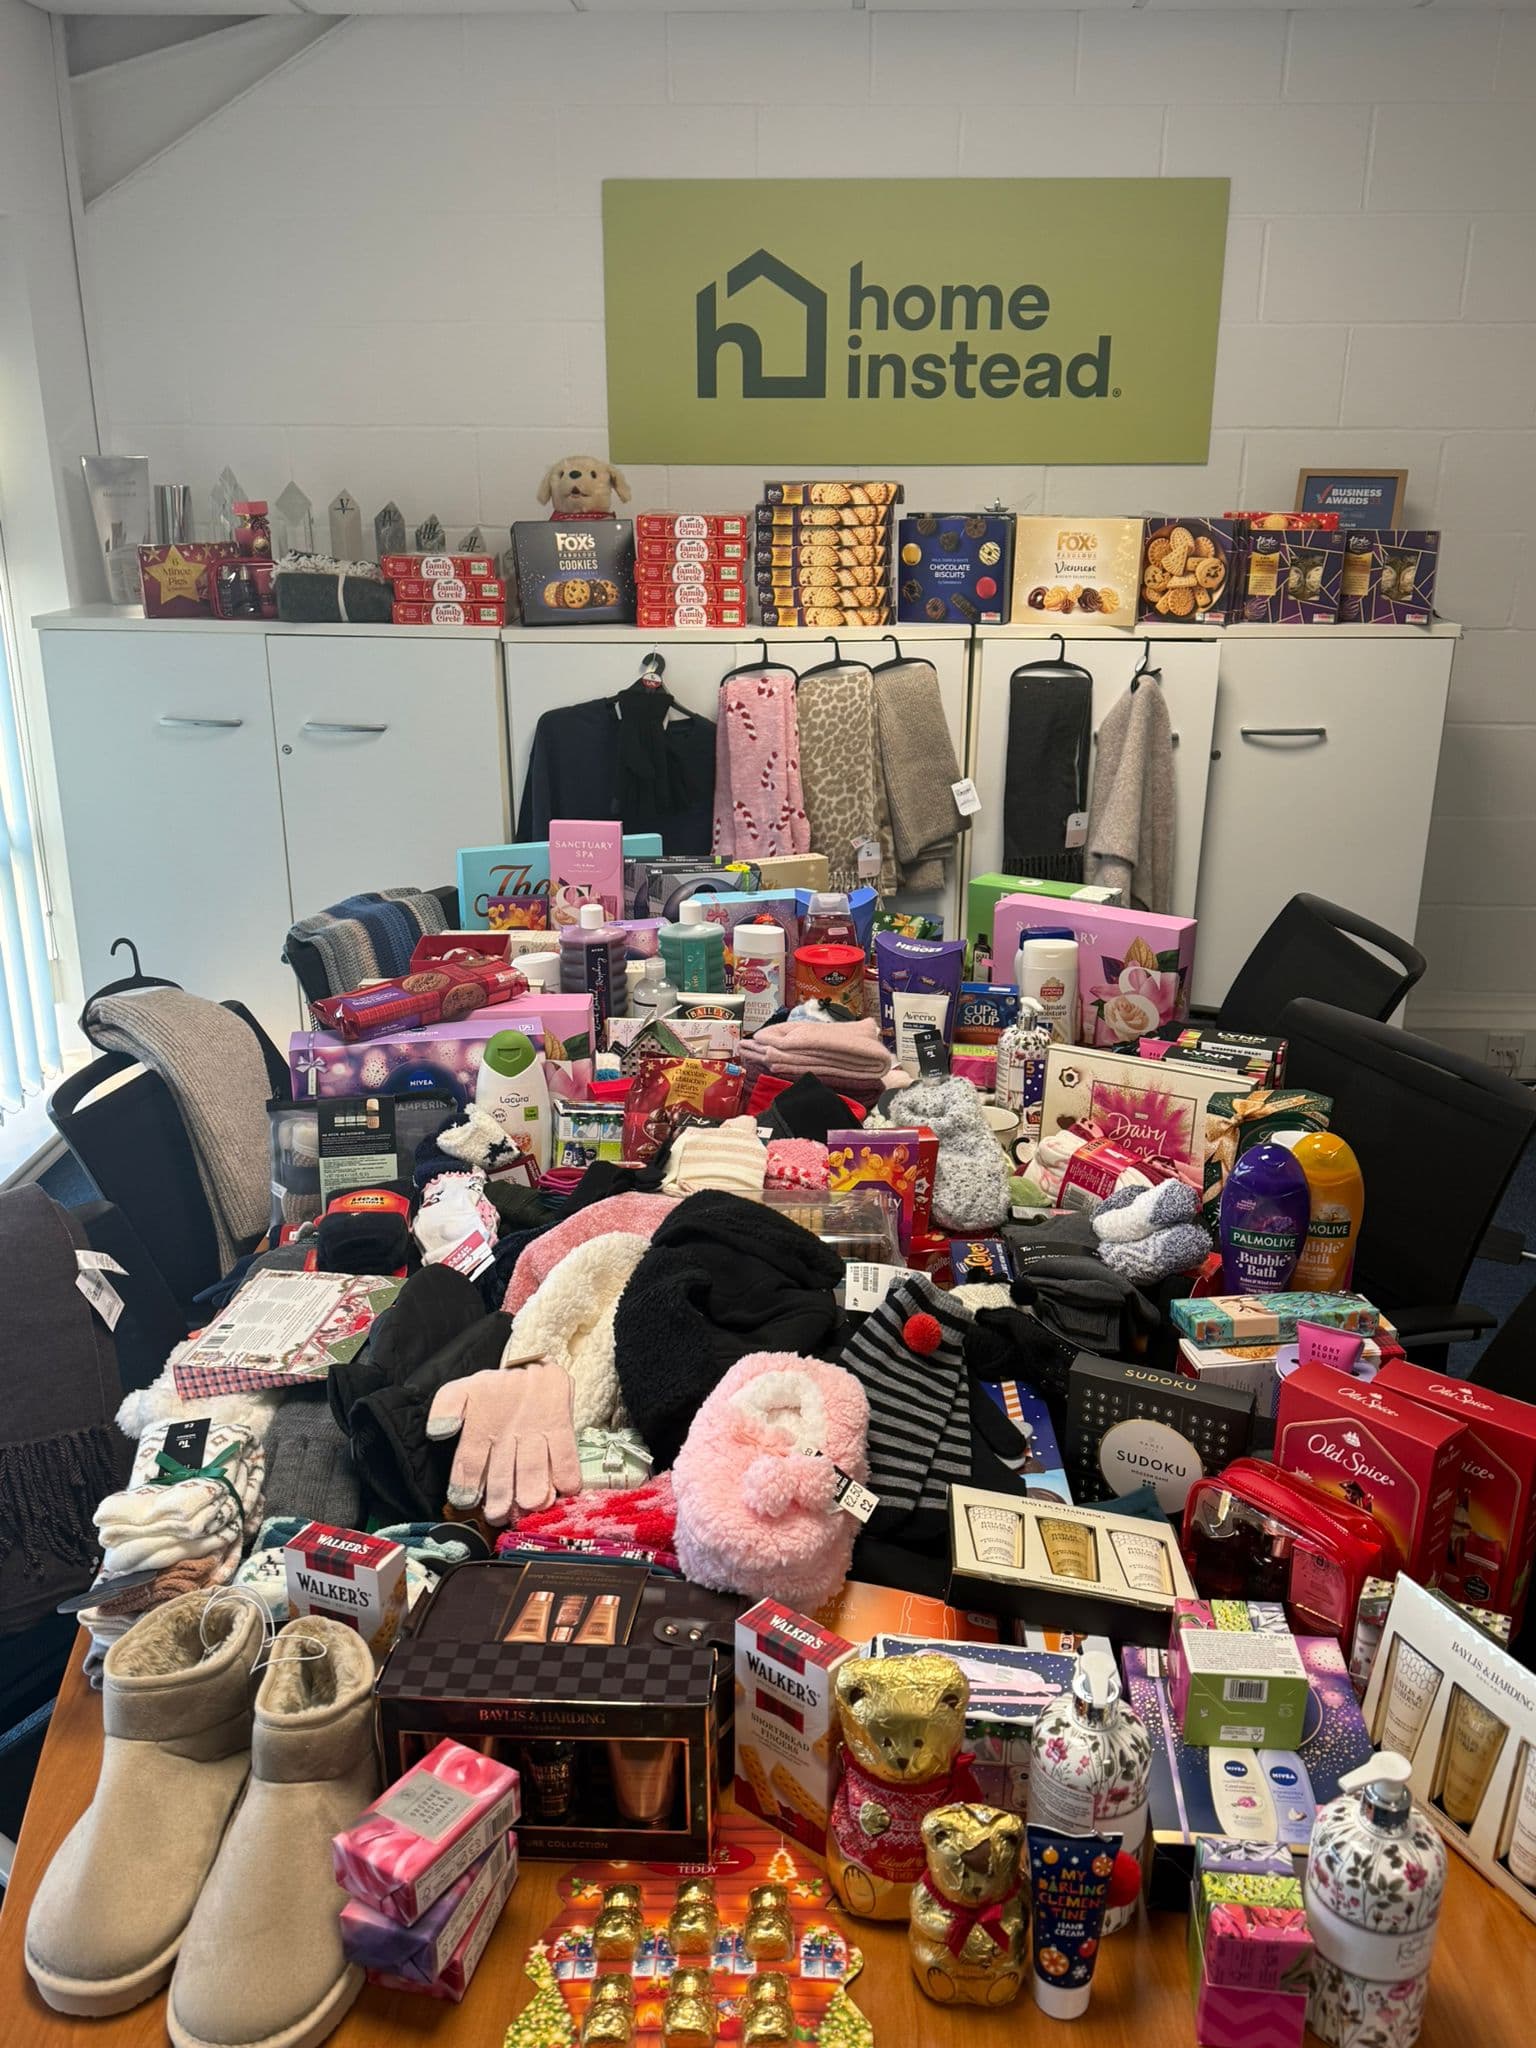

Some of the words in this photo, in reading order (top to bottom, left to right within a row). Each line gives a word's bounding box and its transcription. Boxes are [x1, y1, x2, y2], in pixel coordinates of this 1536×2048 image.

[850, 261, 1050, 331] home
[847, 335, 1112, 398] instead
[1331, 488, 1382, 497] BUSINESS
[1325, 497, 1369, 505] AWARDS
[559, 560, 598, 570] COOKIES
[929, 563, 971, 571] CHOCOLATE
[163, 568, 192, 576] Mince
[934, 571, 966, 579] BISCUITS
[168, 578, 188, 586] Pies
[554, 840, 614, 850] SANCTUARY
[575, 850, 594, 858] SPA
[896, 941, 944, 953] HEROES
[690, 1006, 731, 1018] BAILEYS
[903, 1011, 936, 1022] Aveeno
[963, 1015, 1000, 1026] SOUP
[1217, 1031, 1268, 1042] LYNX
[1182, 1048, 1234, 1061] LYNX
[1026, 1062, 1034, 1073] 5
[500, 1096, 529, 1104] Lacura
[1107, 1112, 1168, 1157] Dairy
[1309, 1224, 1349, 1235] MOLIVE
[1233, 1232, 1297, 1248] PALMOLIVE
[1303, 1241, 1340, 1254] ubble
[1239, 1251, 1286, 1268] Bubble
[1247, 1263, 1277, 1278] Bath
[1311, 1342, 1340, 1354] PEONY
[1311, 1349, 1339, 1361] BLUSH
[1124, 1369, 1197, 1391] SUDOKU
[1338, 1387, 1367, 1402] Old
[1364, 1397, 1395, 1416] Spice
[1428, 1384, 1456, 1398] Old
[1455, 1394, 1490, 1411] Spice
[1116, 1449, 1186, 1477] SUDOKU
[1307, 1433, 1343, 1464] Old
[1343, 1452, 1391, 1486] Spice
[1461, 1459, 1489, 1480] ice
[860, 1499, 874, 1512] £2
[316, 1533, 370, 1555] WALKER'S
[296, 1571, 370, 1608] WALKER'S
[769, 1614, 824, 1650] WALKER'S
[746, 1650, 818, 1707] WALKER'S
[1451, 1641, 1482, 1671] BAYLIS
[1490, 1672, 1535, 1711] HARDING
[479, 1709, 526, 1721] BAYLIS
[542, 1712, 606, 1725] HARDING
[751, 1712, 810, 1752] SHORTBREAD
[760, 1727, 800, 1755] FINGERS
[547, 1840, 609, 1849] COLLECTION
[678, 1865, 718, 1874] TEDDY
[1061, 1868, 1087, 1881] MY
[1039, 1892, 1101, 1908] CLEMEN
[1051, 1907, 1087, 1921] TINE
[1057, 1922, 1084, 1930] HAND
[1054, 1929, 1085, 1937] CREAM
